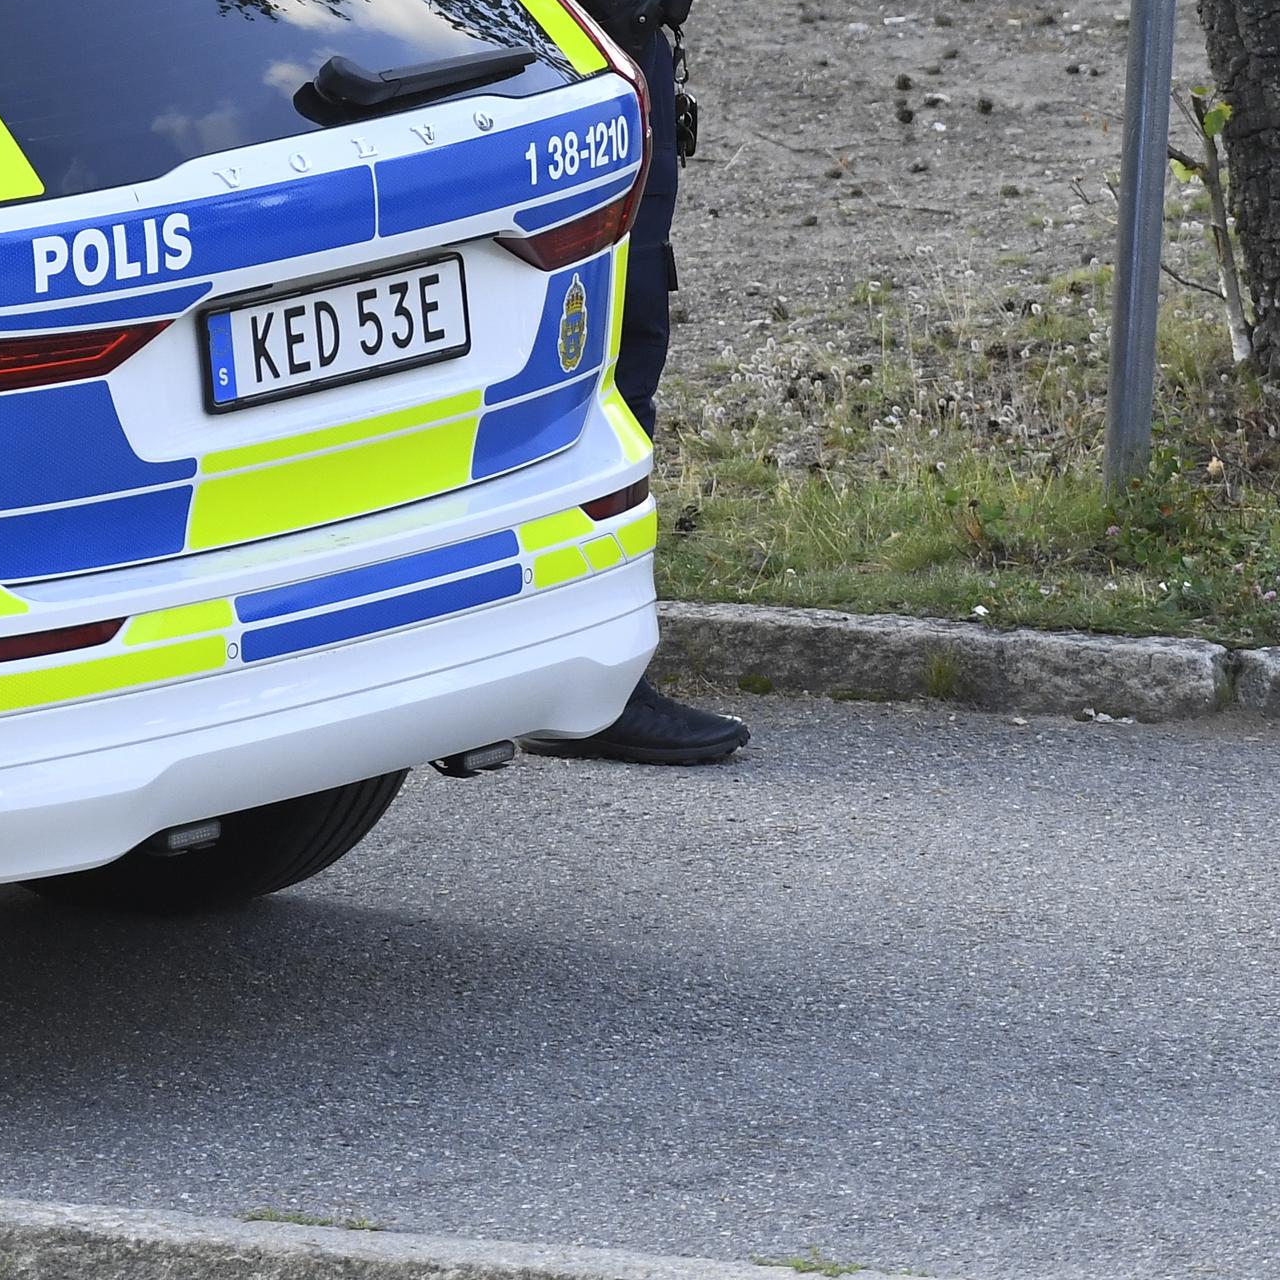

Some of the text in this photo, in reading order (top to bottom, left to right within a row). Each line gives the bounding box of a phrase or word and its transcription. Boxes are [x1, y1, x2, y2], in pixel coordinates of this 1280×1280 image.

[213, 111, 494, 188] VOLVO
[525, 115, 628, 185] 1 38-1210
[32, 213, 192, 293] POLIS
[251, 273, 446, 383] KED 53E
[219, 367, 229, 386] S
